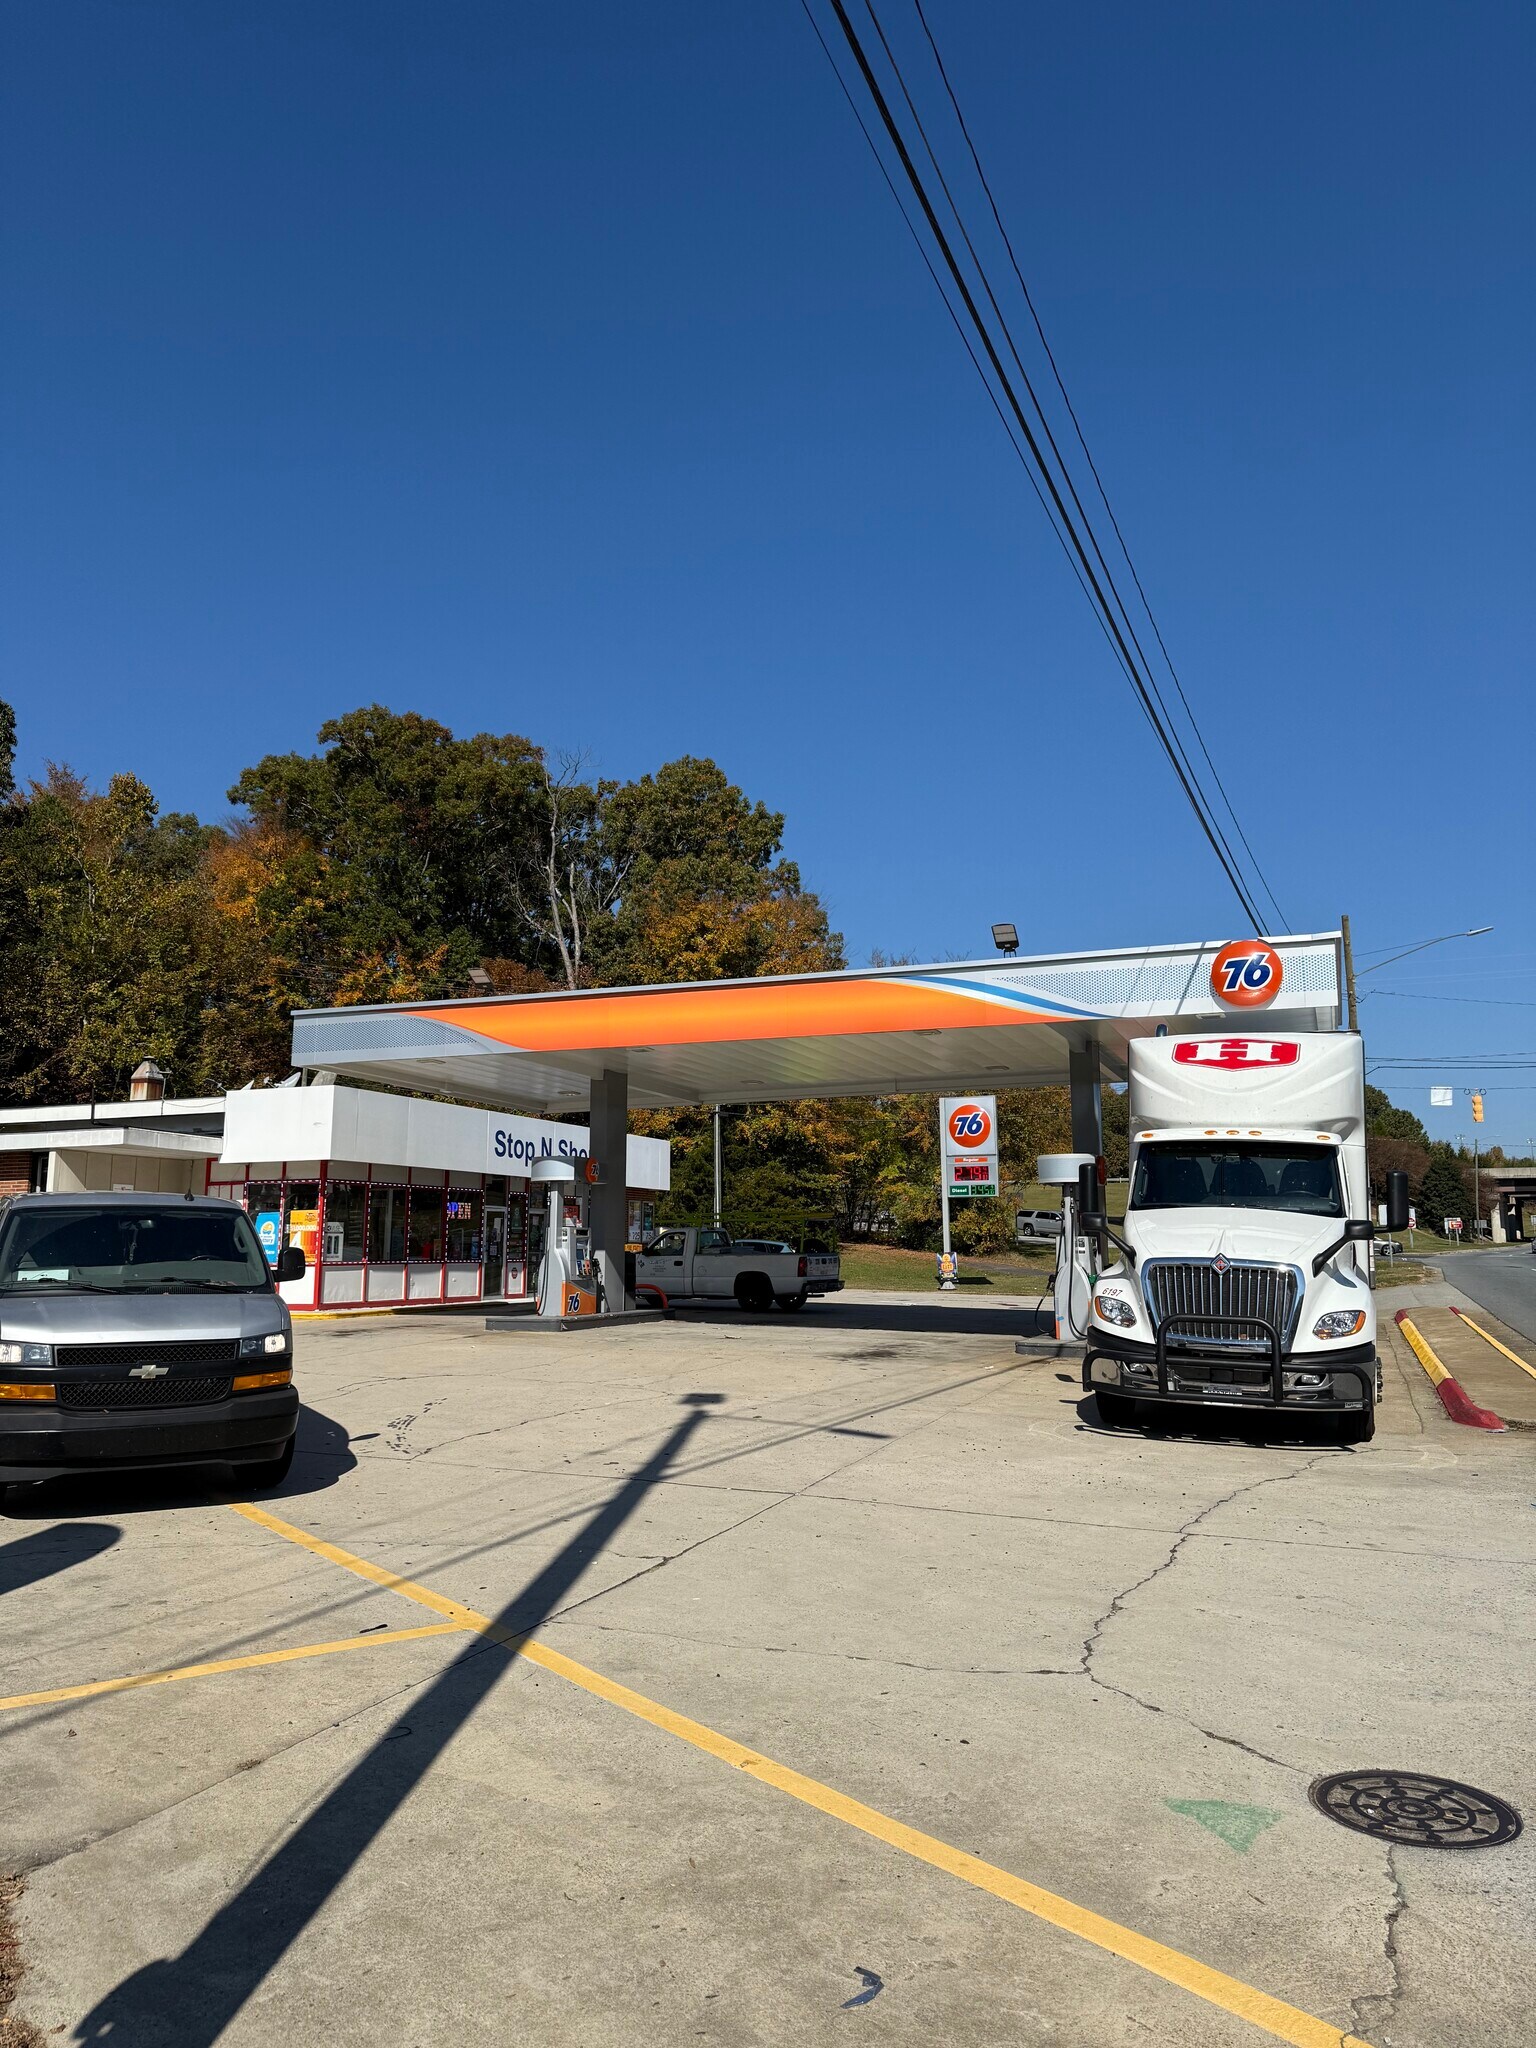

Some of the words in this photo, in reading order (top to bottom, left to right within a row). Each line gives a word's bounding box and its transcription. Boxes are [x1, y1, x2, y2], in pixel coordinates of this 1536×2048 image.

[1220, 952, 1272, 993] 76
[953, 1111, 984, 1137] 76
[494, 1130, 535, 1167] Stop
[541, 1137, 552, 1157] N
[558, 1139, 588, 1158] Sho
[567, 1292, 580, 1313] 76
[1102, 1287, 1123, 1297] 6197
